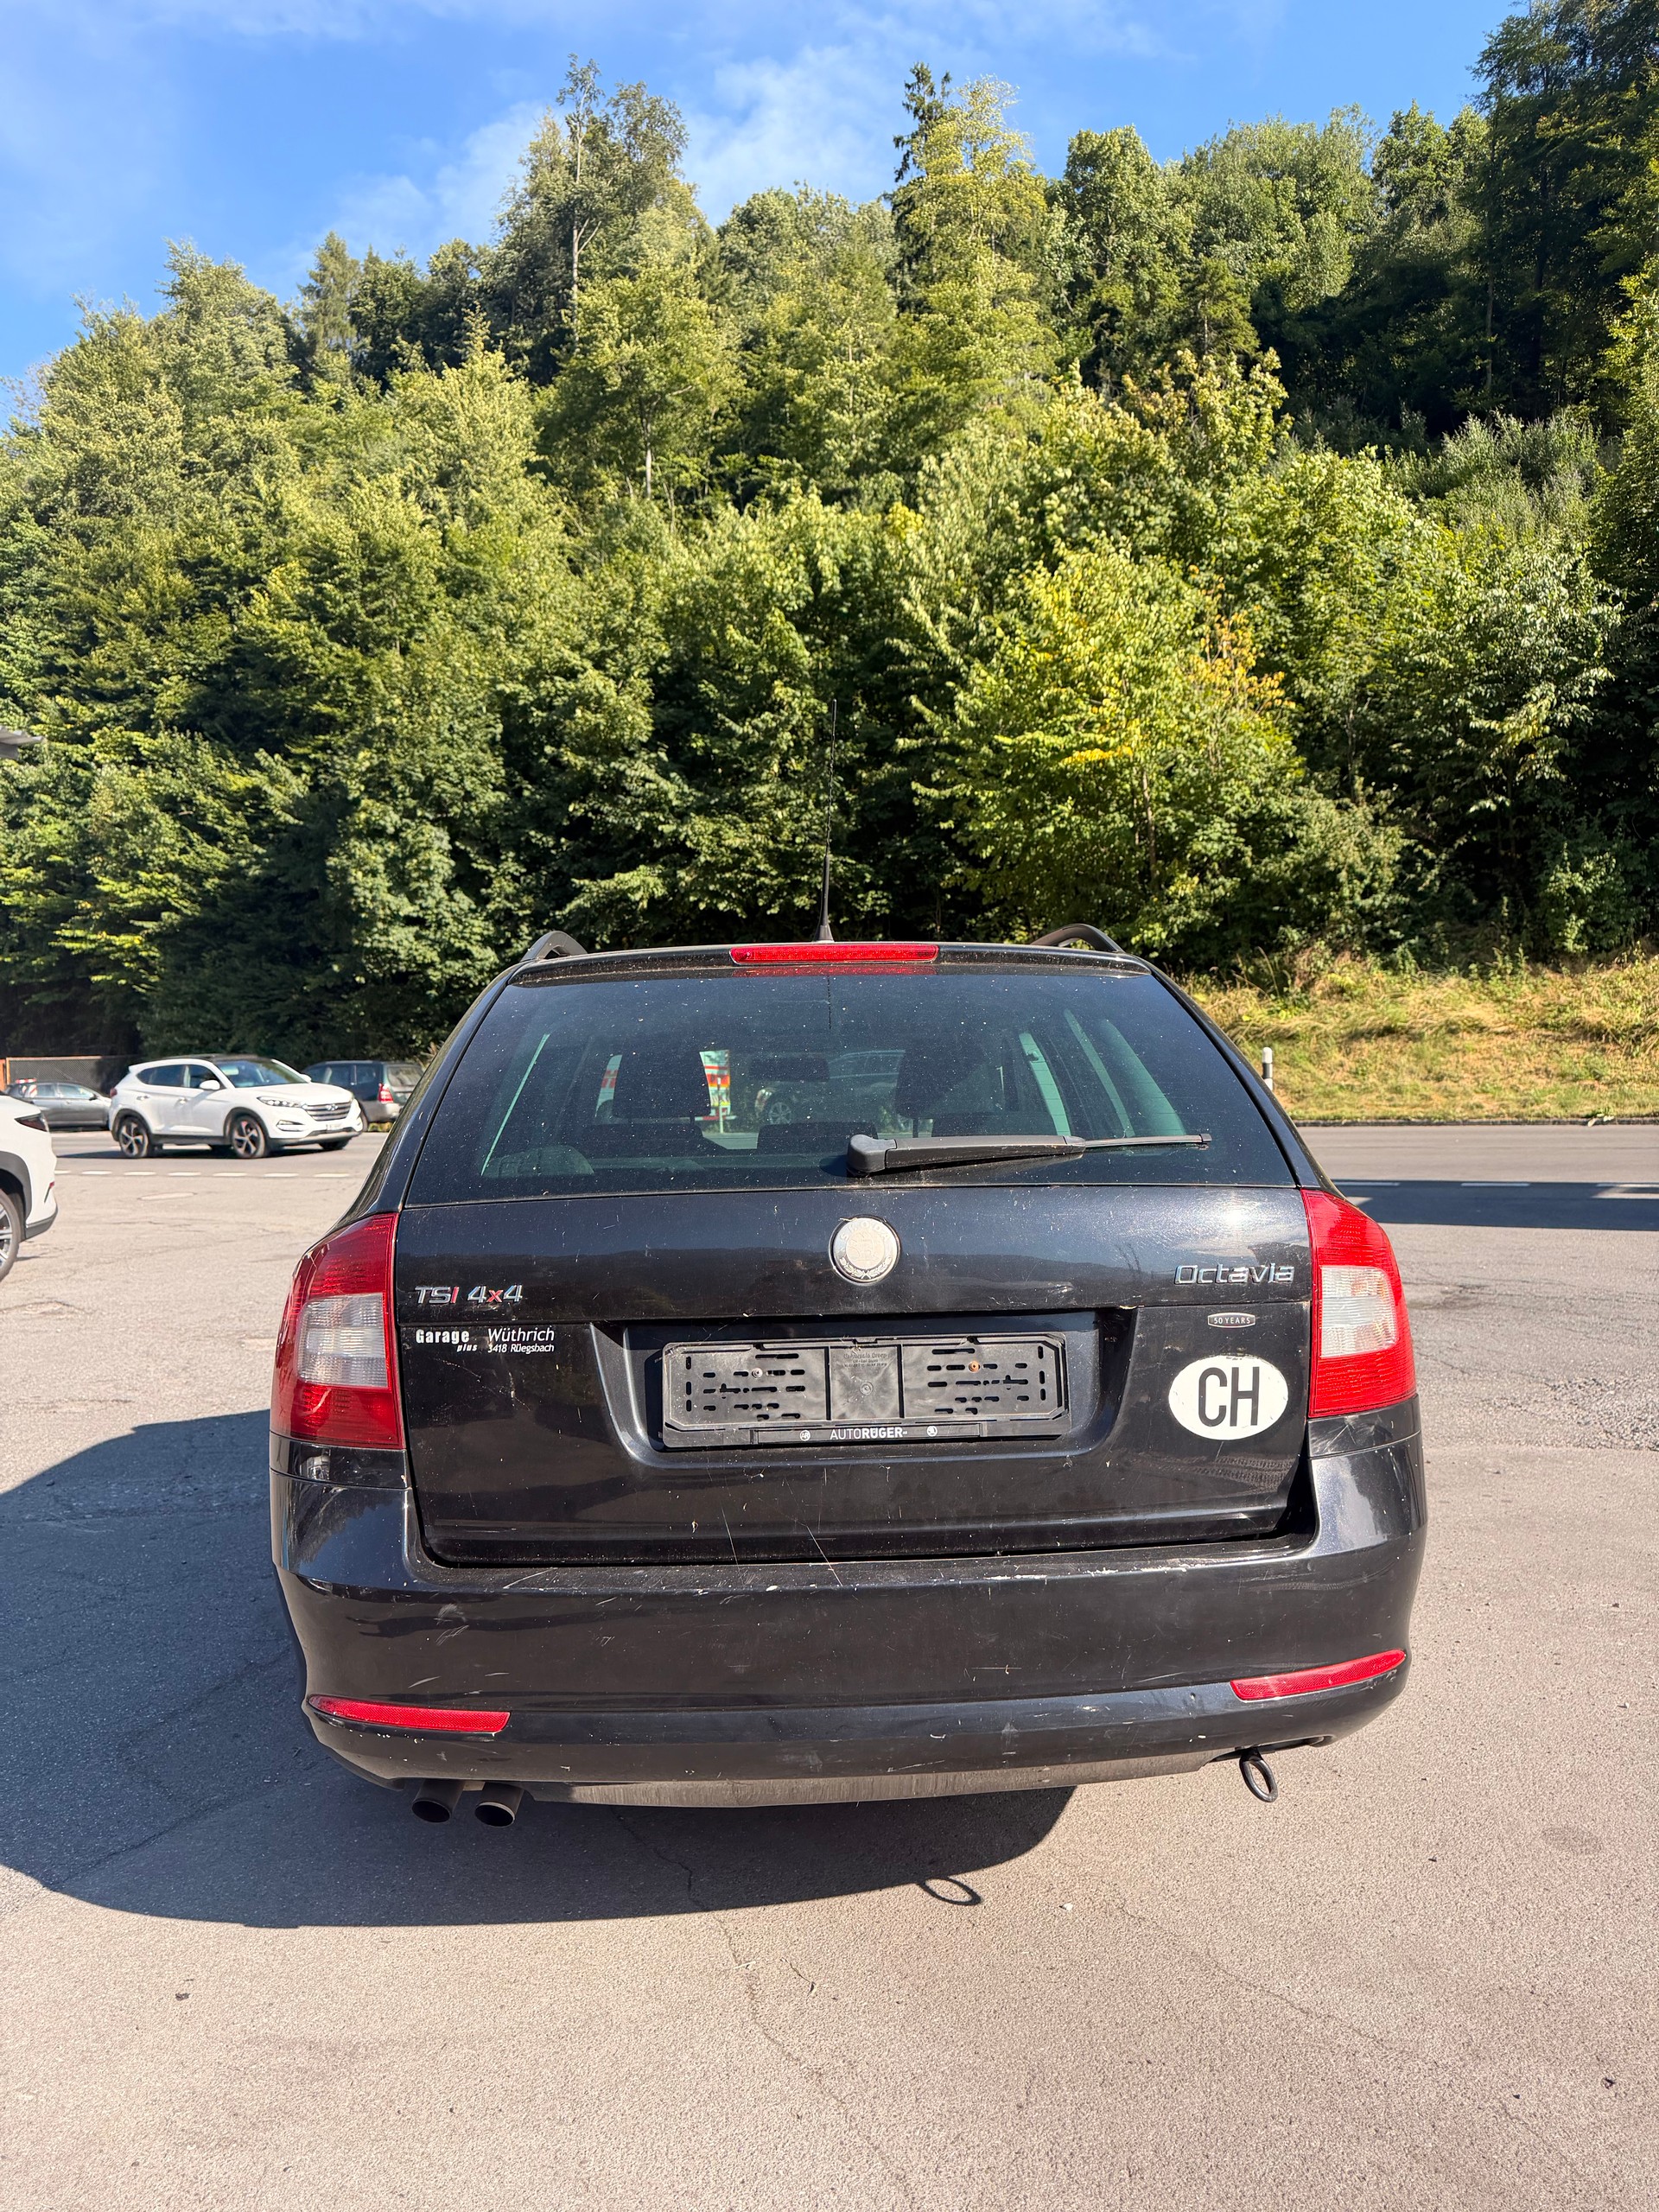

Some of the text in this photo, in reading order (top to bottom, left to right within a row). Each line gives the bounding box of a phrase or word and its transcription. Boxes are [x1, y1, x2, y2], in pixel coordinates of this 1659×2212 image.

[1174, 1262, 1294, 1285] Octavia
[415, 1284, 523, 1304] TSI 4x4
[416, 1329, 470, 1344] Garage
[487, 1327, 555, 1342] Wüthrich
[456, 1344, 478, 1352] plus
[487, 1343, 555, 1355] 3418 Rüegsbach
[1198, 1366, 1260, 1427] CH
